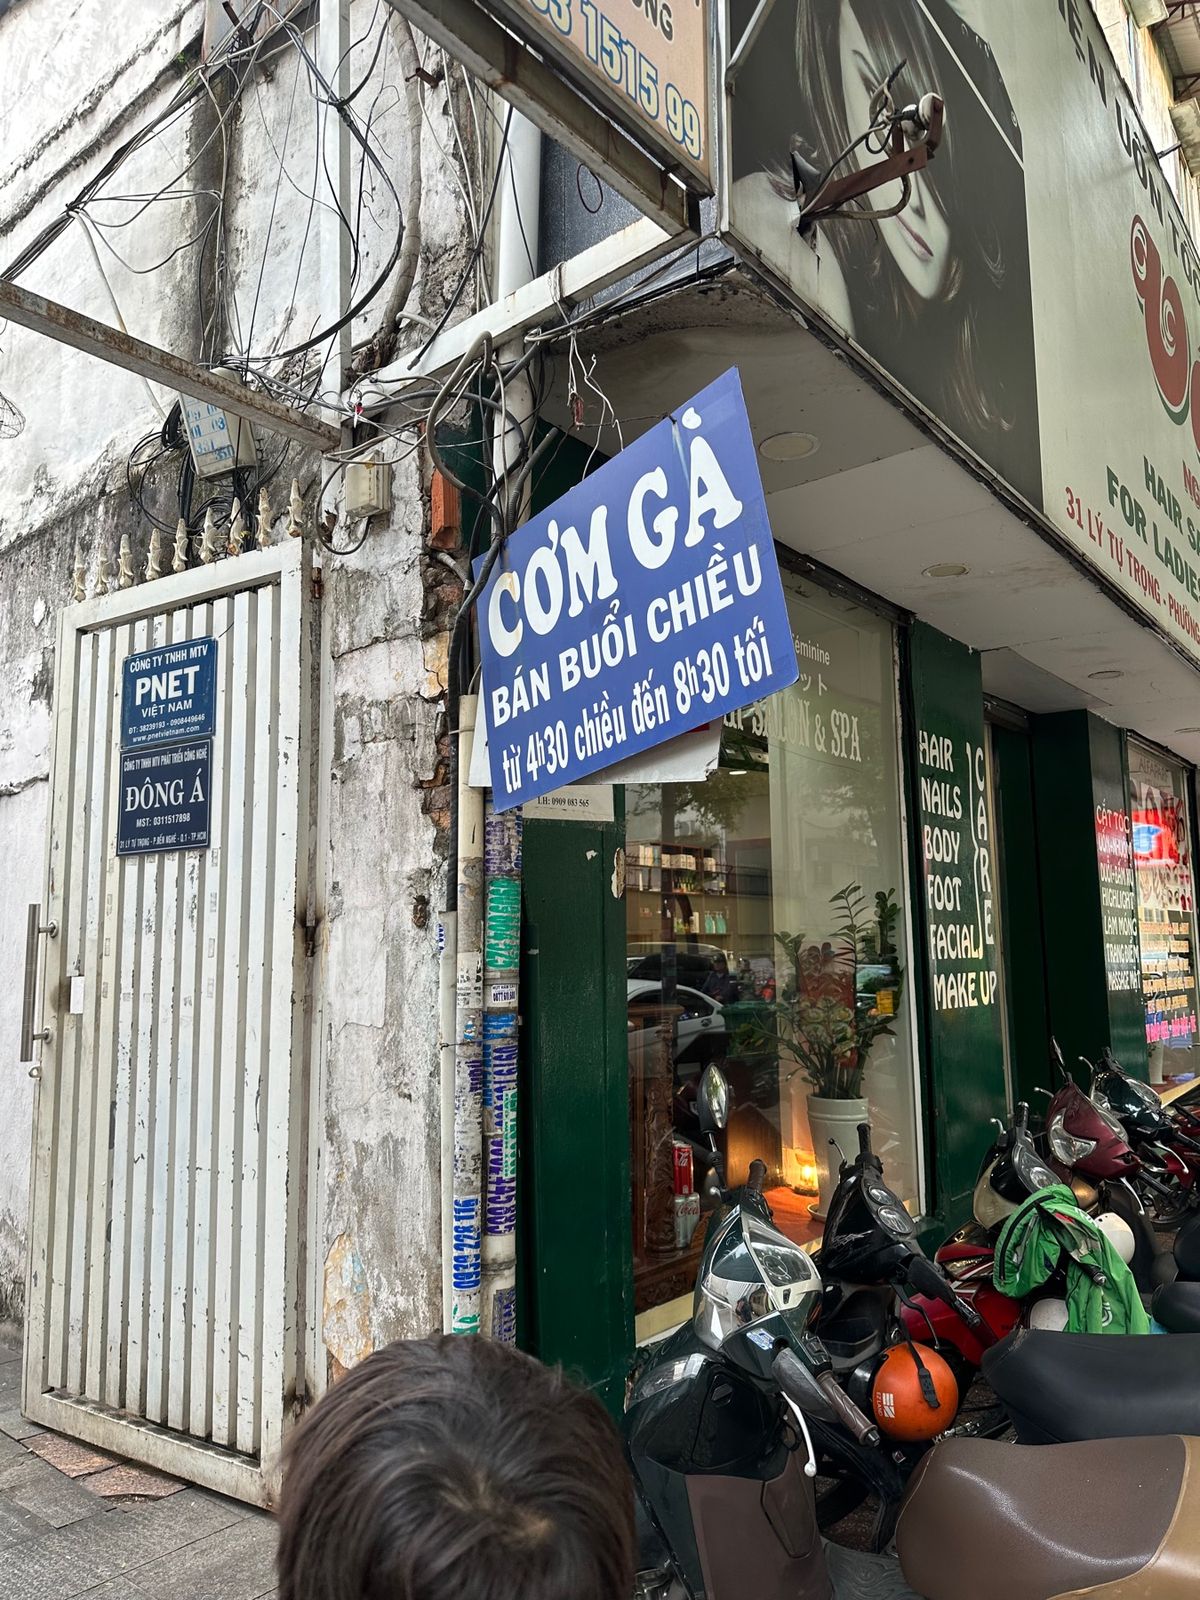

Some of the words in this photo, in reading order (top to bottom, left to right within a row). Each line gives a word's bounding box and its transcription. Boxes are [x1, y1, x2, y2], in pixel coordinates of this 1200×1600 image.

[580, 0, 660, 120] 1515
[665, 83, 701, 160] 99
[1106, 465, 1148, 545] FOR
[1143, 455, 1184, 535] HAIR
[1065, 486, 1084, 530] 31
[1087, 508, 1104, 548] LÝ
[1107, 528, 1124, 572] TỰ
[1126, 547, 1162, 606] TRỌNG
[488, 505, 618, 657] CƠM
[491, 665, 551, 728] BÁN
[559, 599, 638, 691] BUỔI
[646, 543, 762, 643] CHIỀU
[792, 634, 830, 666] éminine
[130, 657, 151, 673] CÔNG
[153, 655, 163, 667] TY
[165, 649, 187, 664] TNHH
[189, 644, 208, 659] MTV
[135, 665, 200, 706] PNET
[502, 741, 522, 794] từ
[527, 720, 568, 782] 4h30
[574, 691, 626, 760] chiều
[631, 669, 670, 735] đến
[673, 642, 730, 715] 8h30
[734, 616, 773, 687] tối
[141, 703, 165, 718] VIỆT
[168, 699, 192, 713] NAM
[132, 725, 200, 743] www.pnetvietnam.com
[814, 713, 828, 753] &
[830, 709, 862, 762] SPA
[919, 730, 954, 773] HAIR
[124, 758, 135, 772] CÔNG
[135, 760, 140, 769] TY
[140, 757, 151, 769] TNHH
[152, 756, 160, 767] MTV
[160, 751, 171, 766] PHÁT
[171, 748, 183, 764] TRIỂN
[184, 748, 195, 762] CÔNG
[196, 745, 207, 760] NGHỆ
[125, 777, 184, 812] ĐÔNG
[189, 768, 205, 803] Á
[921, 776, 962, 820] NAILS
[136, 817, 152, 828] MST:
[1096, 798, 1113, 828] CẮT
[1114, 808, 1130, 834] TÓC
[924, 824, 960, 864] BODY
[974, 747, 995, 946] CARE
[927, 874, 961, 912] FOOT
[1101, 887, 1134, 910] HIGHLIGHT
[929, 923, 979, 961] FACIAL
[1104, 910, 1118, 935] LÀM
[1118, 912, 1137, 936] MÓNG
[933, 971, 977, 1010] MAKE
[979, 970, 997, 1005] UP
[1108, 970, 1129, 991] MASSAGE
